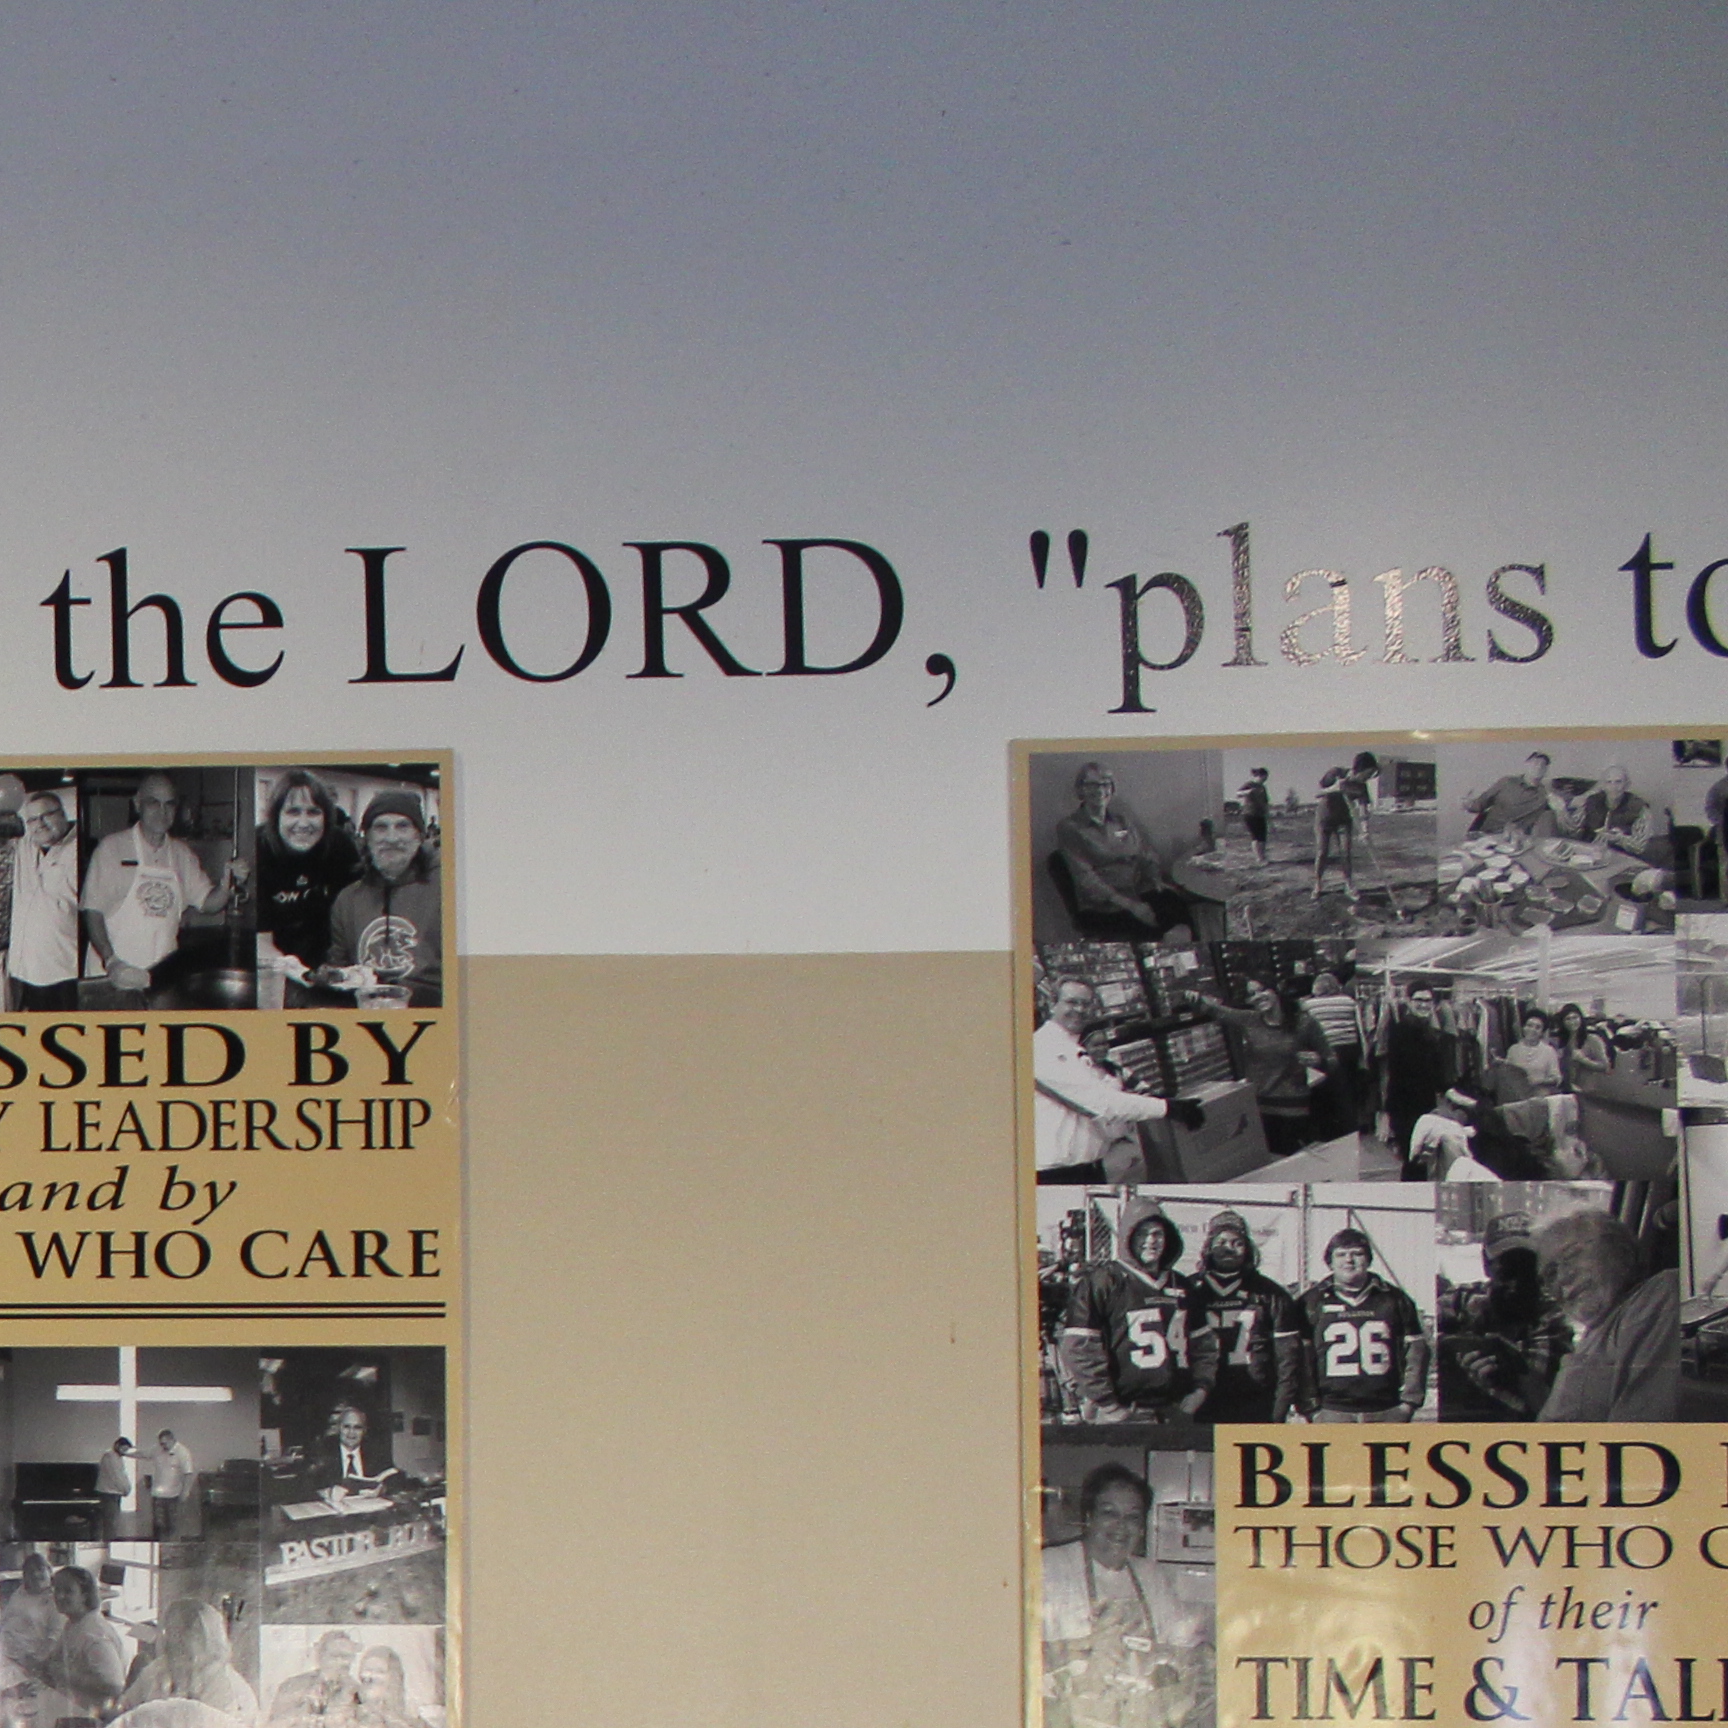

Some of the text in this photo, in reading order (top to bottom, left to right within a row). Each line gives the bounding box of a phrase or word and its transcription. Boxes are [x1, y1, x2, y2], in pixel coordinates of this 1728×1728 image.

[40, 546, 286, 692] the
[345, 537, 958, 708] LORD,
[1029, 521, 1556, 715] "plans
[287, 1021, 437, 1088] BY
[40, 1097, 433, 1154] LEADERSHIP
[159, 1165, 239, 1227] by
[16, 1230, 213, 1281] WHO
[240, 1229, 442, 1280] CARE
[1323, 1320, 1391, 1377] 26
[1234, 1440, 1683, 1510] BLESSED
[1234, 1525, 1459, 1570] THOSE
[1482, 1525, 1675, 1570] WHO
[1468, 1586, 1660, 1645] of their
[1236, 1656, 1728, 1723] TIME & TAL
